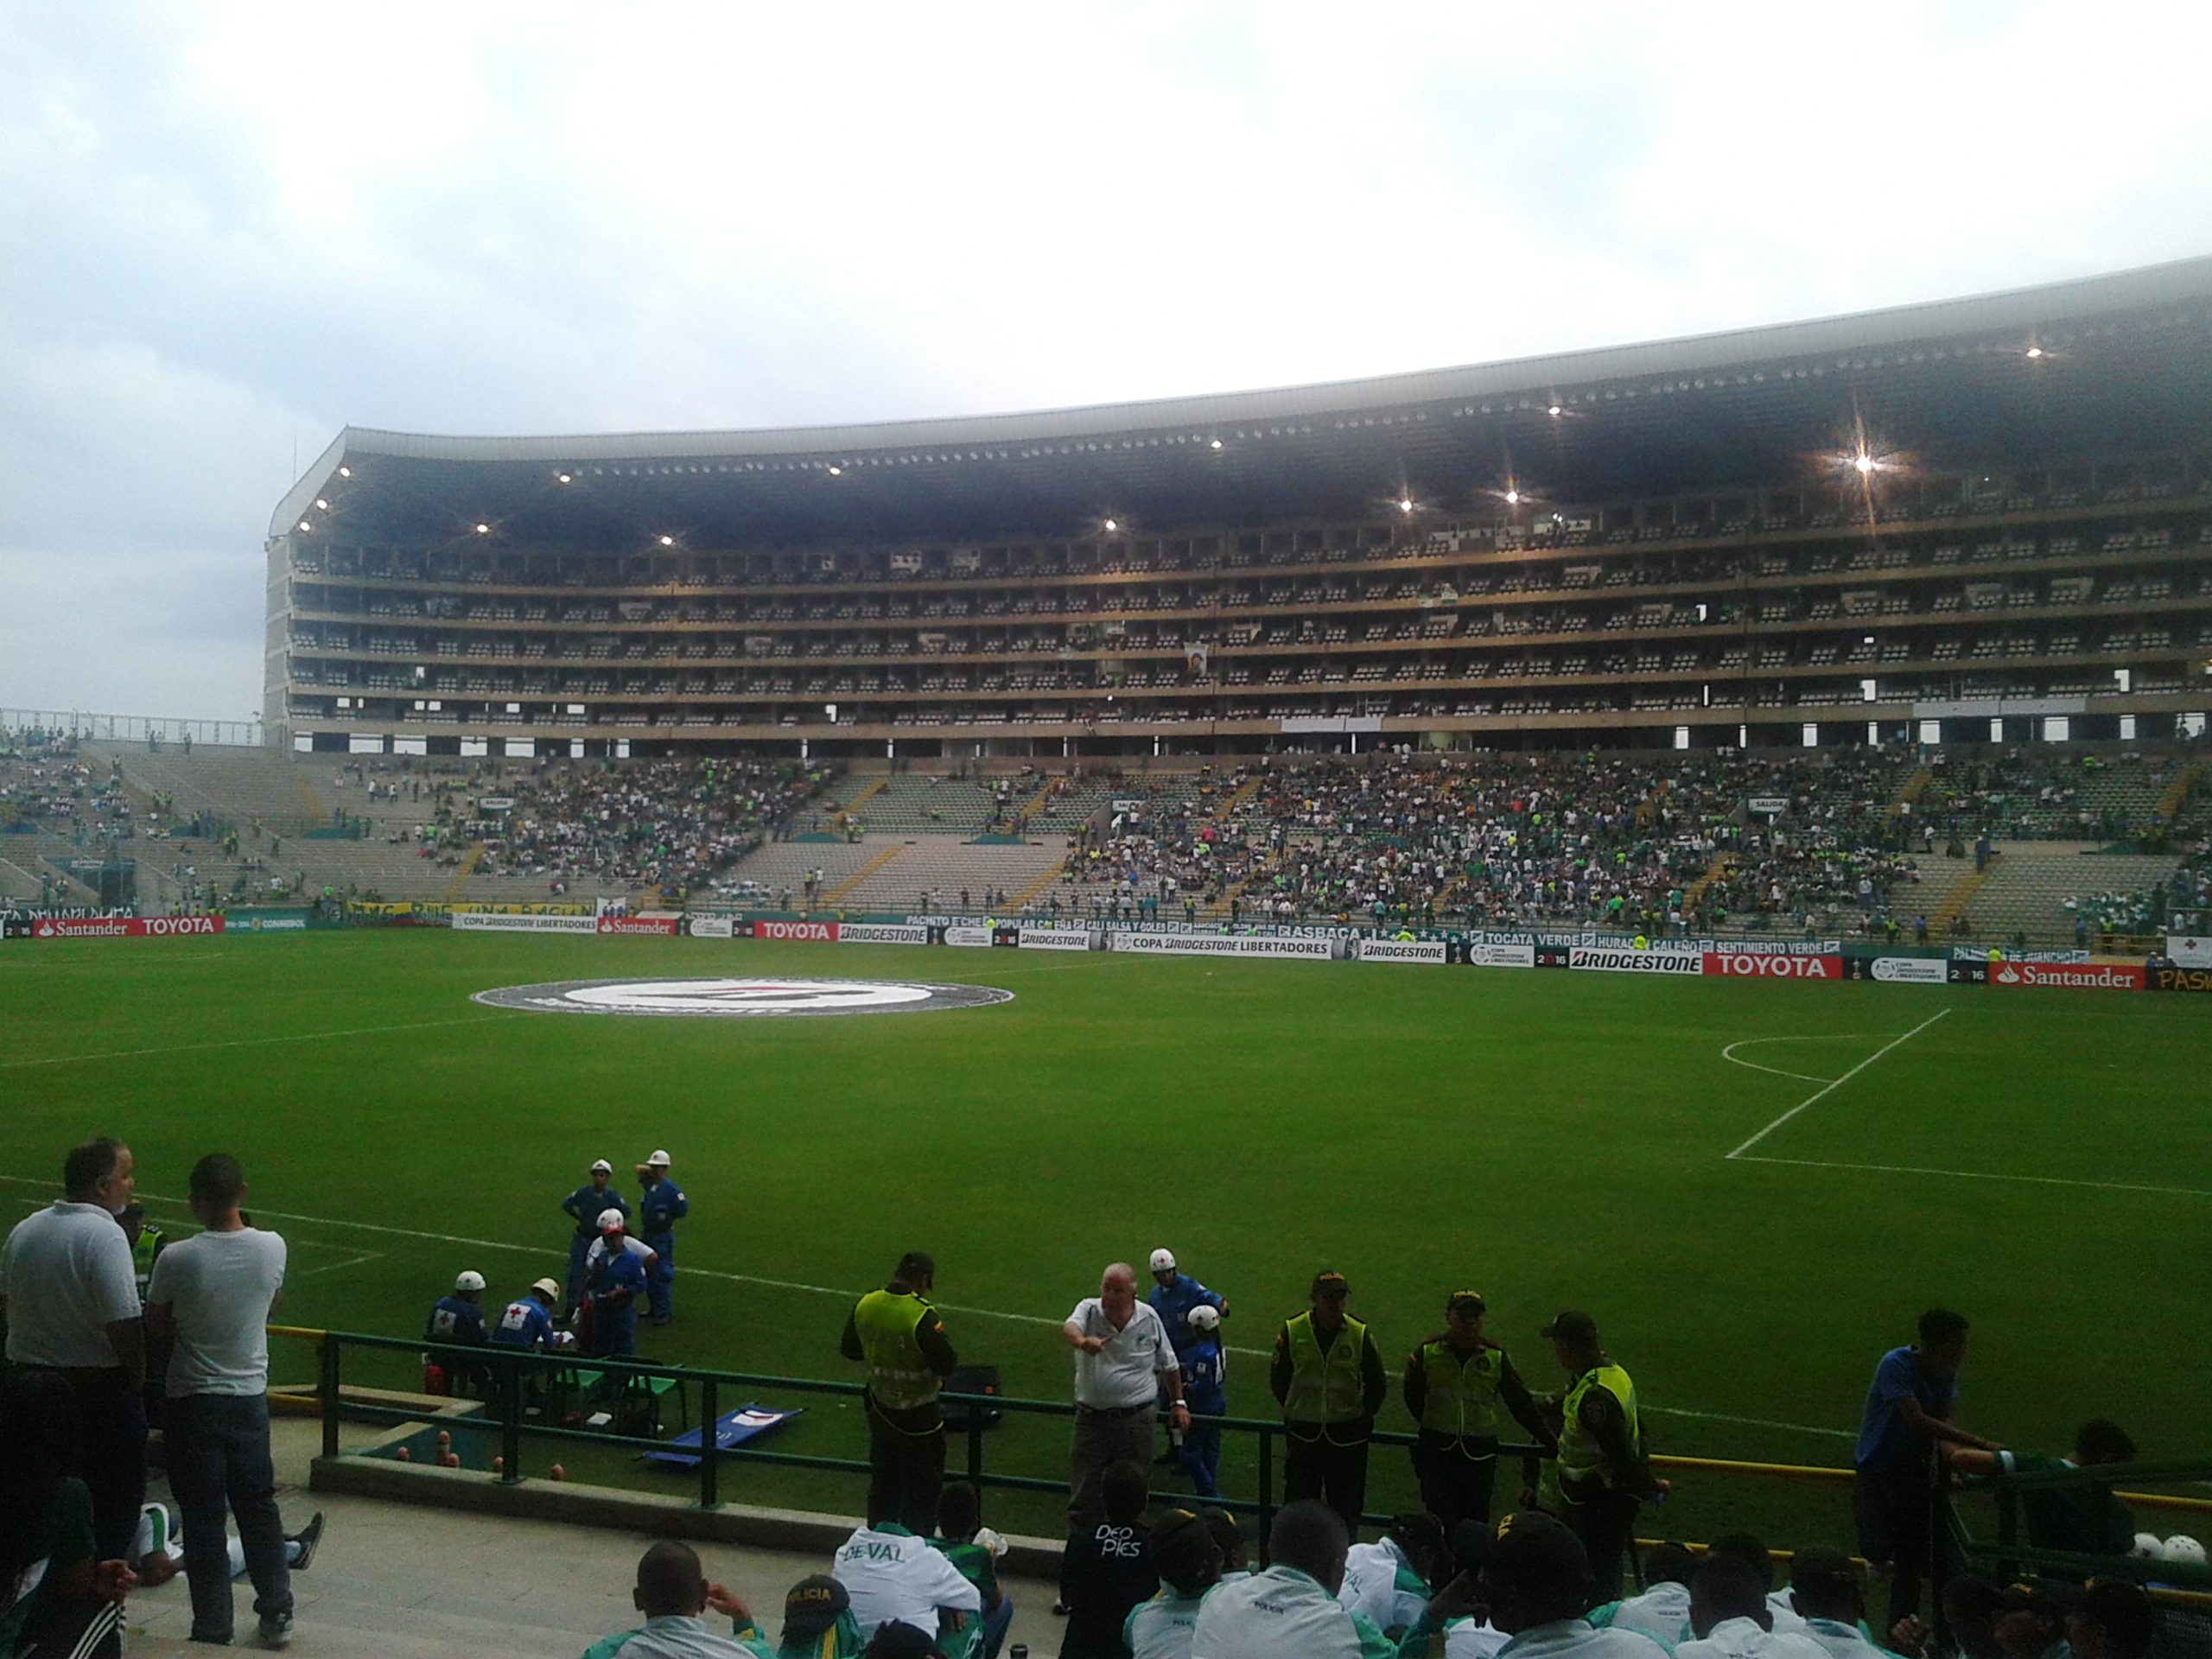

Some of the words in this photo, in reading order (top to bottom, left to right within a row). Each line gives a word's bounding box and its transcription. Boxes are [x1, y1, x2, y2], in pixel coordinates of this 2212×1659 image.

[55, 919, 128, 936] Santander
[143, 918, 214, 934] TOYOTA
[464, 916, 484, 925] COPA
[536, 918, 596, 930] LIBERTADORES
[613, 919, 671, 934] Santander
[907, 915, 950, 926] PACHITO
[995, 918, 1036, 930] POPULAR
[1086, 921, 1104, 931] CALI
[1106, 921, 1132, 931] SALSA
[1132, 922, 1138, 931] Y
[1141, 922, 1166, 932] GOLES
[763, 922, 830, 939] TOYOTA
[840, 925, 925, 941] BRIDGESTONE
[1020, 933, 1087, 946] BRIDGESTONE
[1133, 938, 1162, 949] COPA
[1166, 938, 1237, 952] BRIDGESTONE
[1240, 942, 1328, 955] LIBERTADORES
[1485, 932, 1535, 944] TOCATA
[1537, 933, 1580, 947] VERDE
[1653, 938, 1698, 953] CALEÑO
[1363, 945, 1444, 958] BRIDGESTONE
[1716, 942, 1786, 954] SENTIMIENTO
[1788, 943, 1823, 955] VERDE
[1572, 951, 1701, 972] BRIDGESTONE
[1718, 955, 1827, 977] TOYOTA
[2023, 966, 2135, 988] Santander
[1102, 1538, 1141, 1557] PIES
